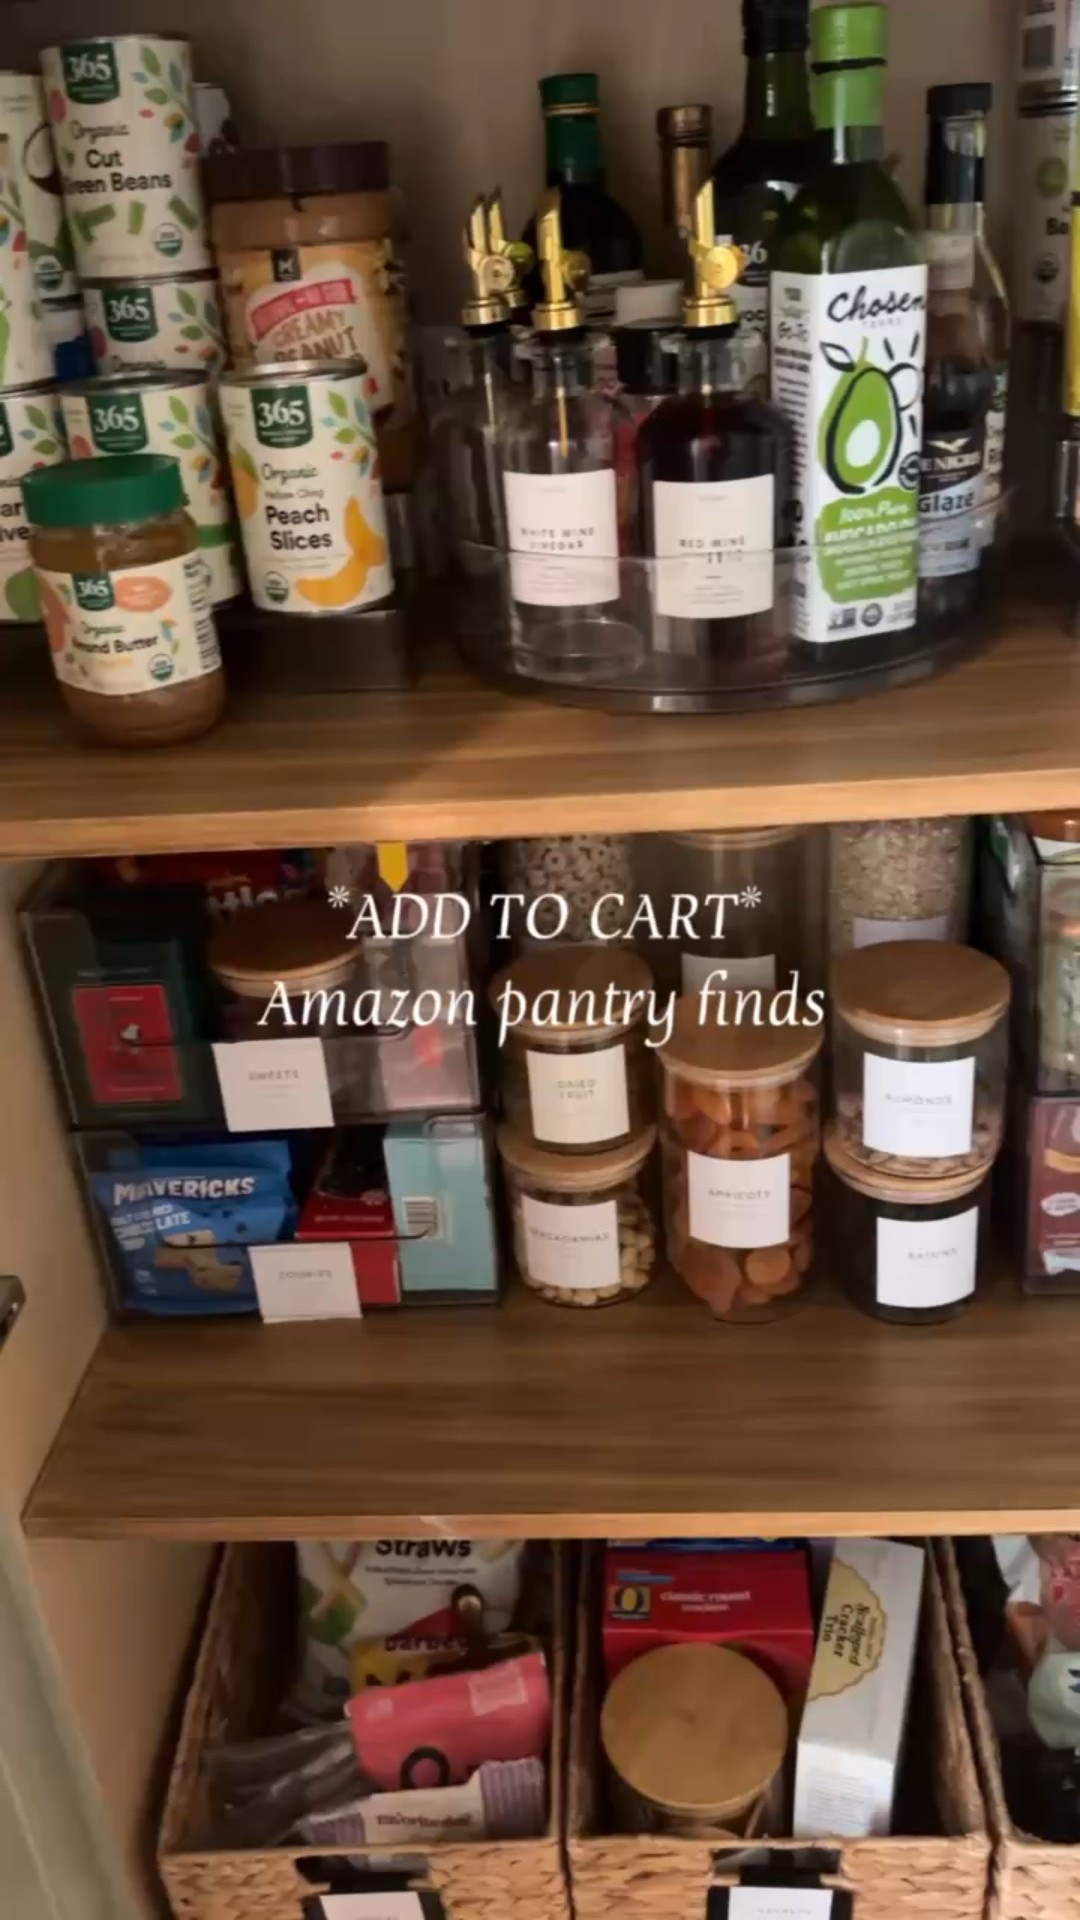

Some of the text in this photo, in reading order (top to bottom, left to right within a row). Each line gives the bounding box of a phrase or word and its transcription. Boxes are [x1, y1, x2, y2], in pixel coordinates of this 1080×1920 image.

[67, 53, 112, 83] 365
[85, 149, 123, 169] Cut
[109, 171, 173, 192] Beans
[108, 295, 151, 323] 365
[826, 283, 926, 323] Chosen
[92, 406, 140, 432] 365
[257, 400, 305, 428] 365
[260, 463, 319, 485] Organic
[919, 488, 976, 514] Glaze
[265, 503, 330, 526] Peach
[269, 529, 333, 551] Slices
[679, 538, 705, 549] RED
[77, 578, 110, 599] 365
[113, 634, 159, 653] Butter
[375, 1538, 472, 1558] Straws
[821, 1614, 840, 1643] Trio
[833, 1603, 856, 1658] Cracker
